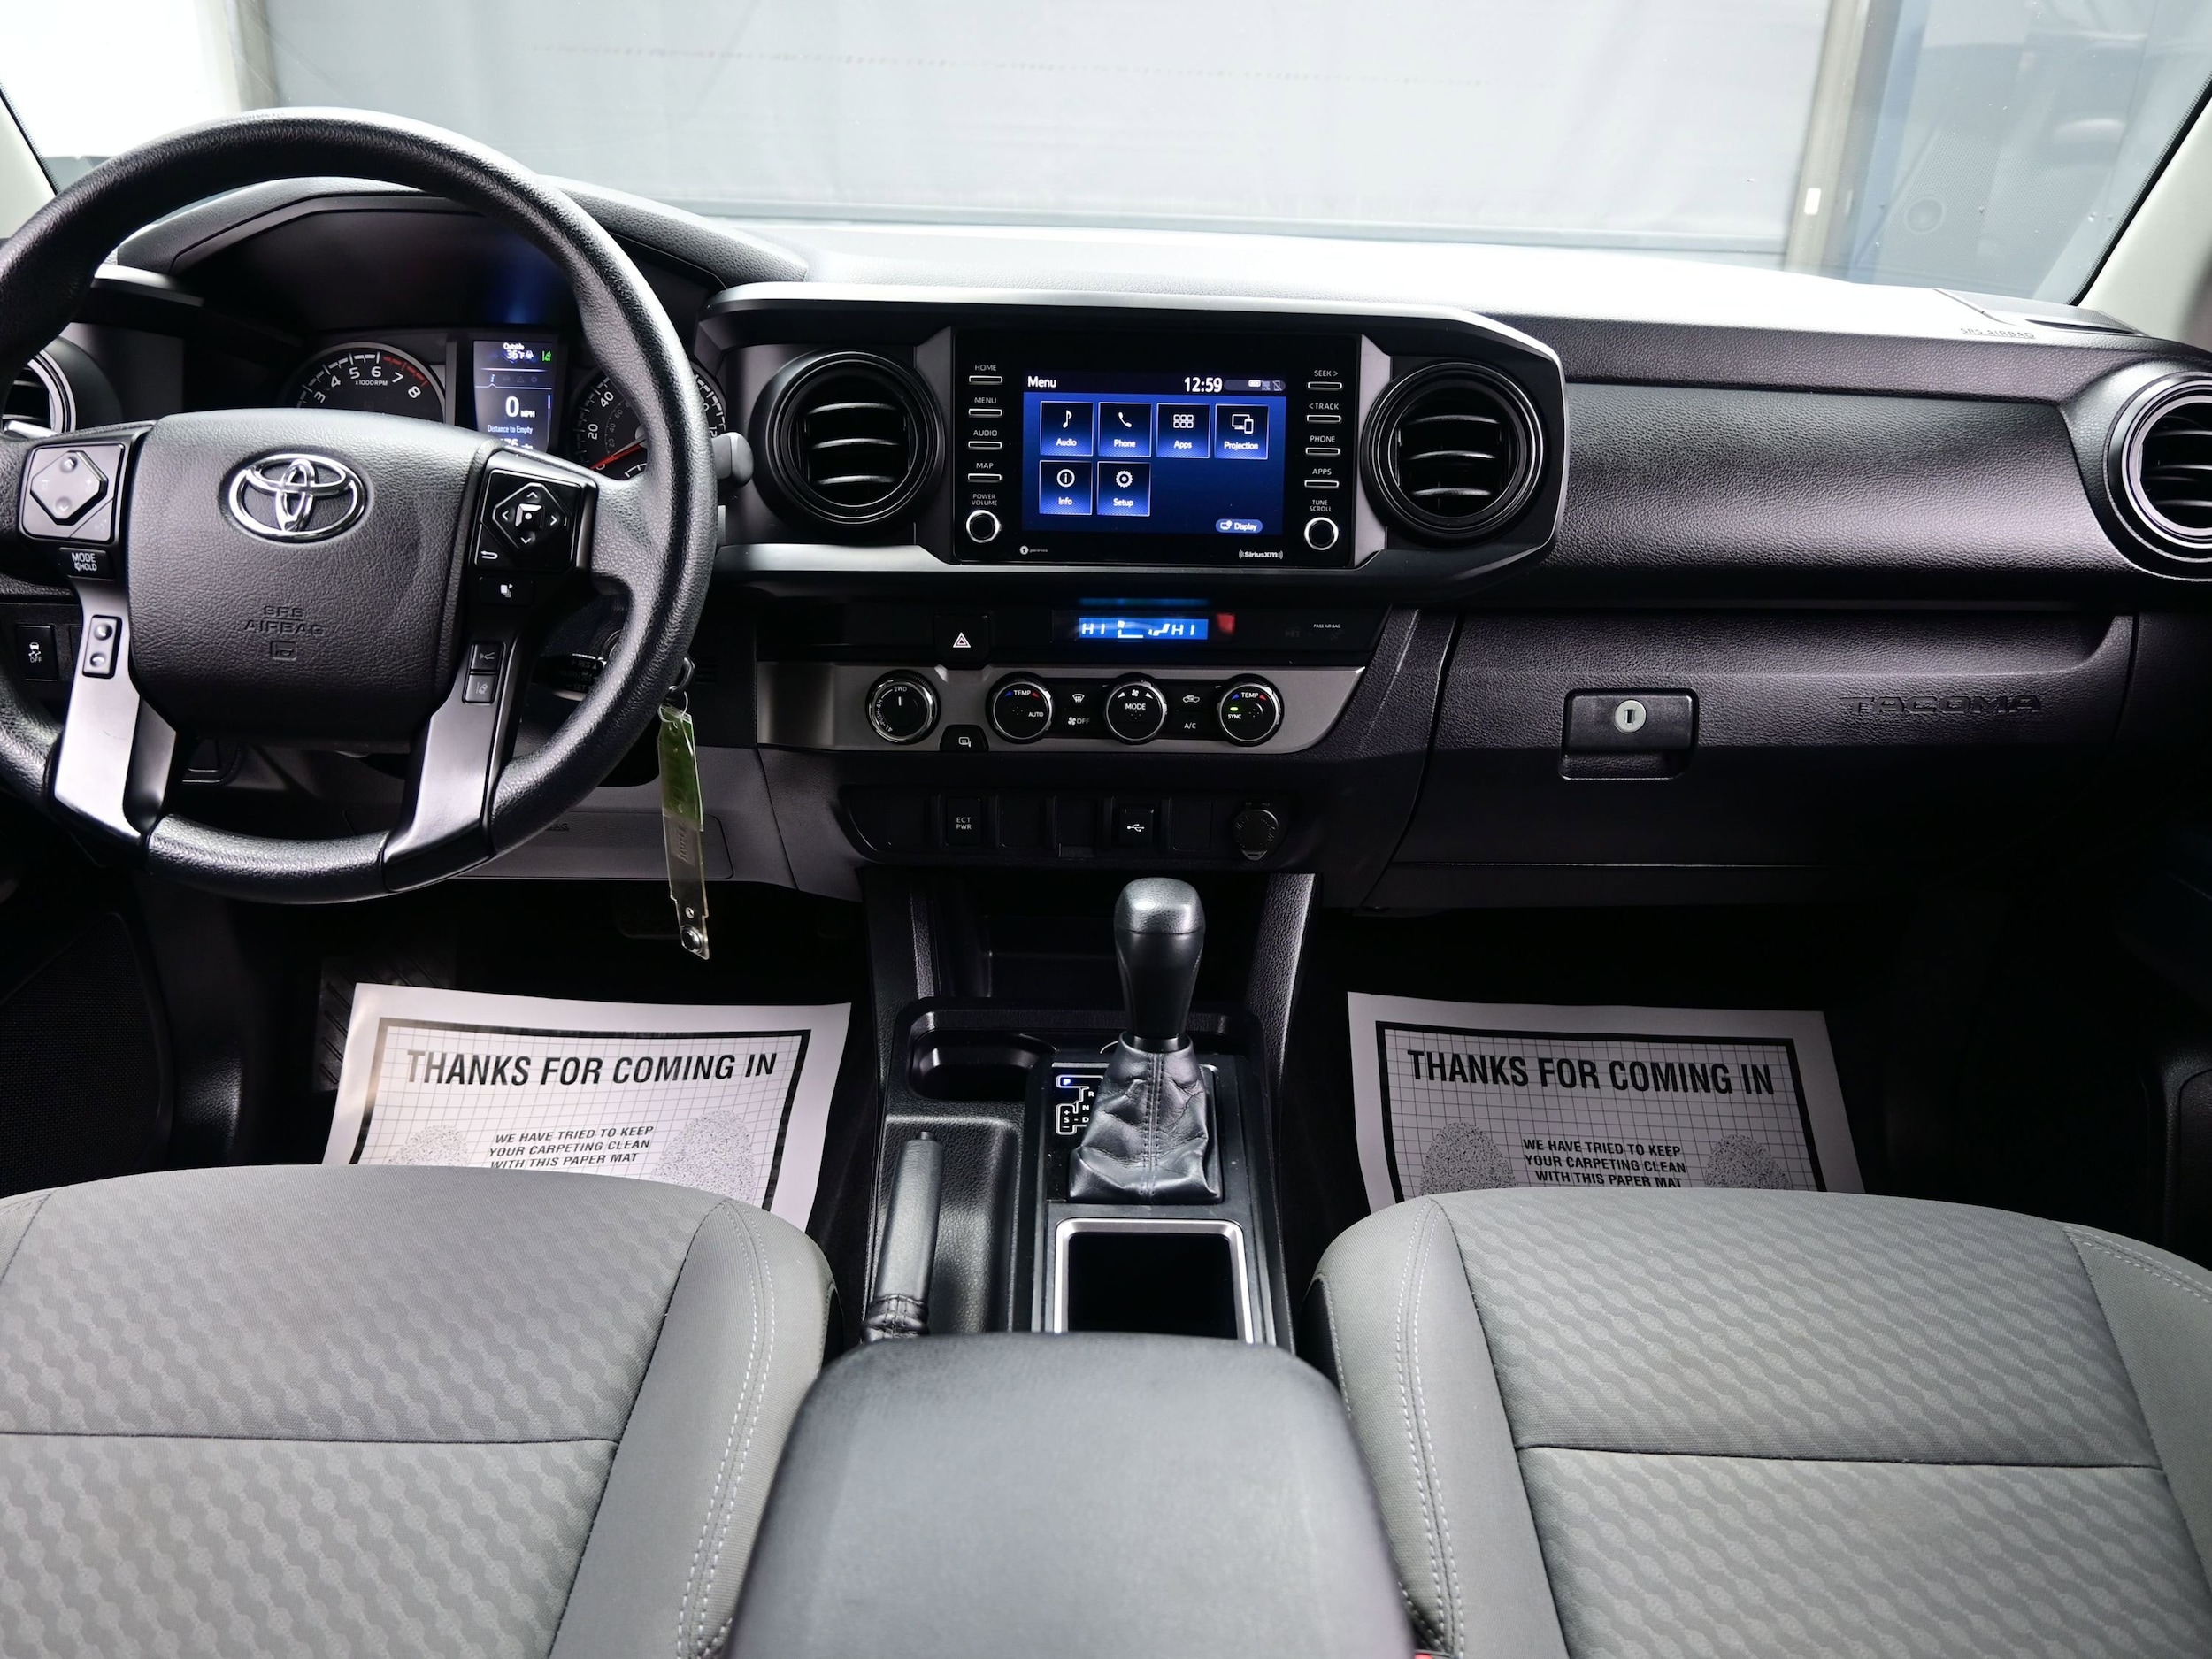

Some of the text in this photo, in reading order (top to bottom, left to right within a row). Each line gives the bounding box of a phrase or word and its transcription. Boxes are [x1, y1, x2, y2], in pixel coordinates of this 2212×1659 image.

[349, 367, 360, 379] 5
[371, 366, 382, 378] 6
[392, 372, 403, 384] 7
[331, 375, 342, 388] 4
[1027, 375, 1057, 388] Menu
[1184, 376, 1223, 393] 12:59
[313, 391, 326, 403] 3
[408, 386, 421, 398] 8
[600, 391, 614, 408] 40
[505, 396, 519, 418] 0
[517, 426, 533, 434] Empty
[588, 423, 598, 440] 20
[1056, 438, 1078, 447] Audio
[1113, 439, 1136, 448] Phone
[1174, 440, 1192, 449] Apps
[1224, 441, 1259, 450] Projection
[1058, 497, 1073, 506] Info
[1113, 498, 1133, 507] Setup
[1234, 522, 1257, 531] Display
[72, 552, 96, 563] MODE
[1839, 695, 2042, 714] TACOMA
[406, 1048, 777, 1087] THANKS FOR COMING IN
[1407, 1048, 1775, 1096] THANKS FOR COMING IN
[495, 1125, 654, 1144] WE HAVE TRIED TO KEEP
[489, 1139, 650, 1157] YOUR CARPETING CLEAN
[1523, 1139, 1681, 1157] WE HAVE TRIED TO KEEP
[490, 1152, 639, 1169] WITH THIS PAPER MAT
[1524, 1155, 1686, 1173] YOUR CARPETING CLEAN
[1534, 1171, 1682, 1187] WITH THIS PAPER MAT
